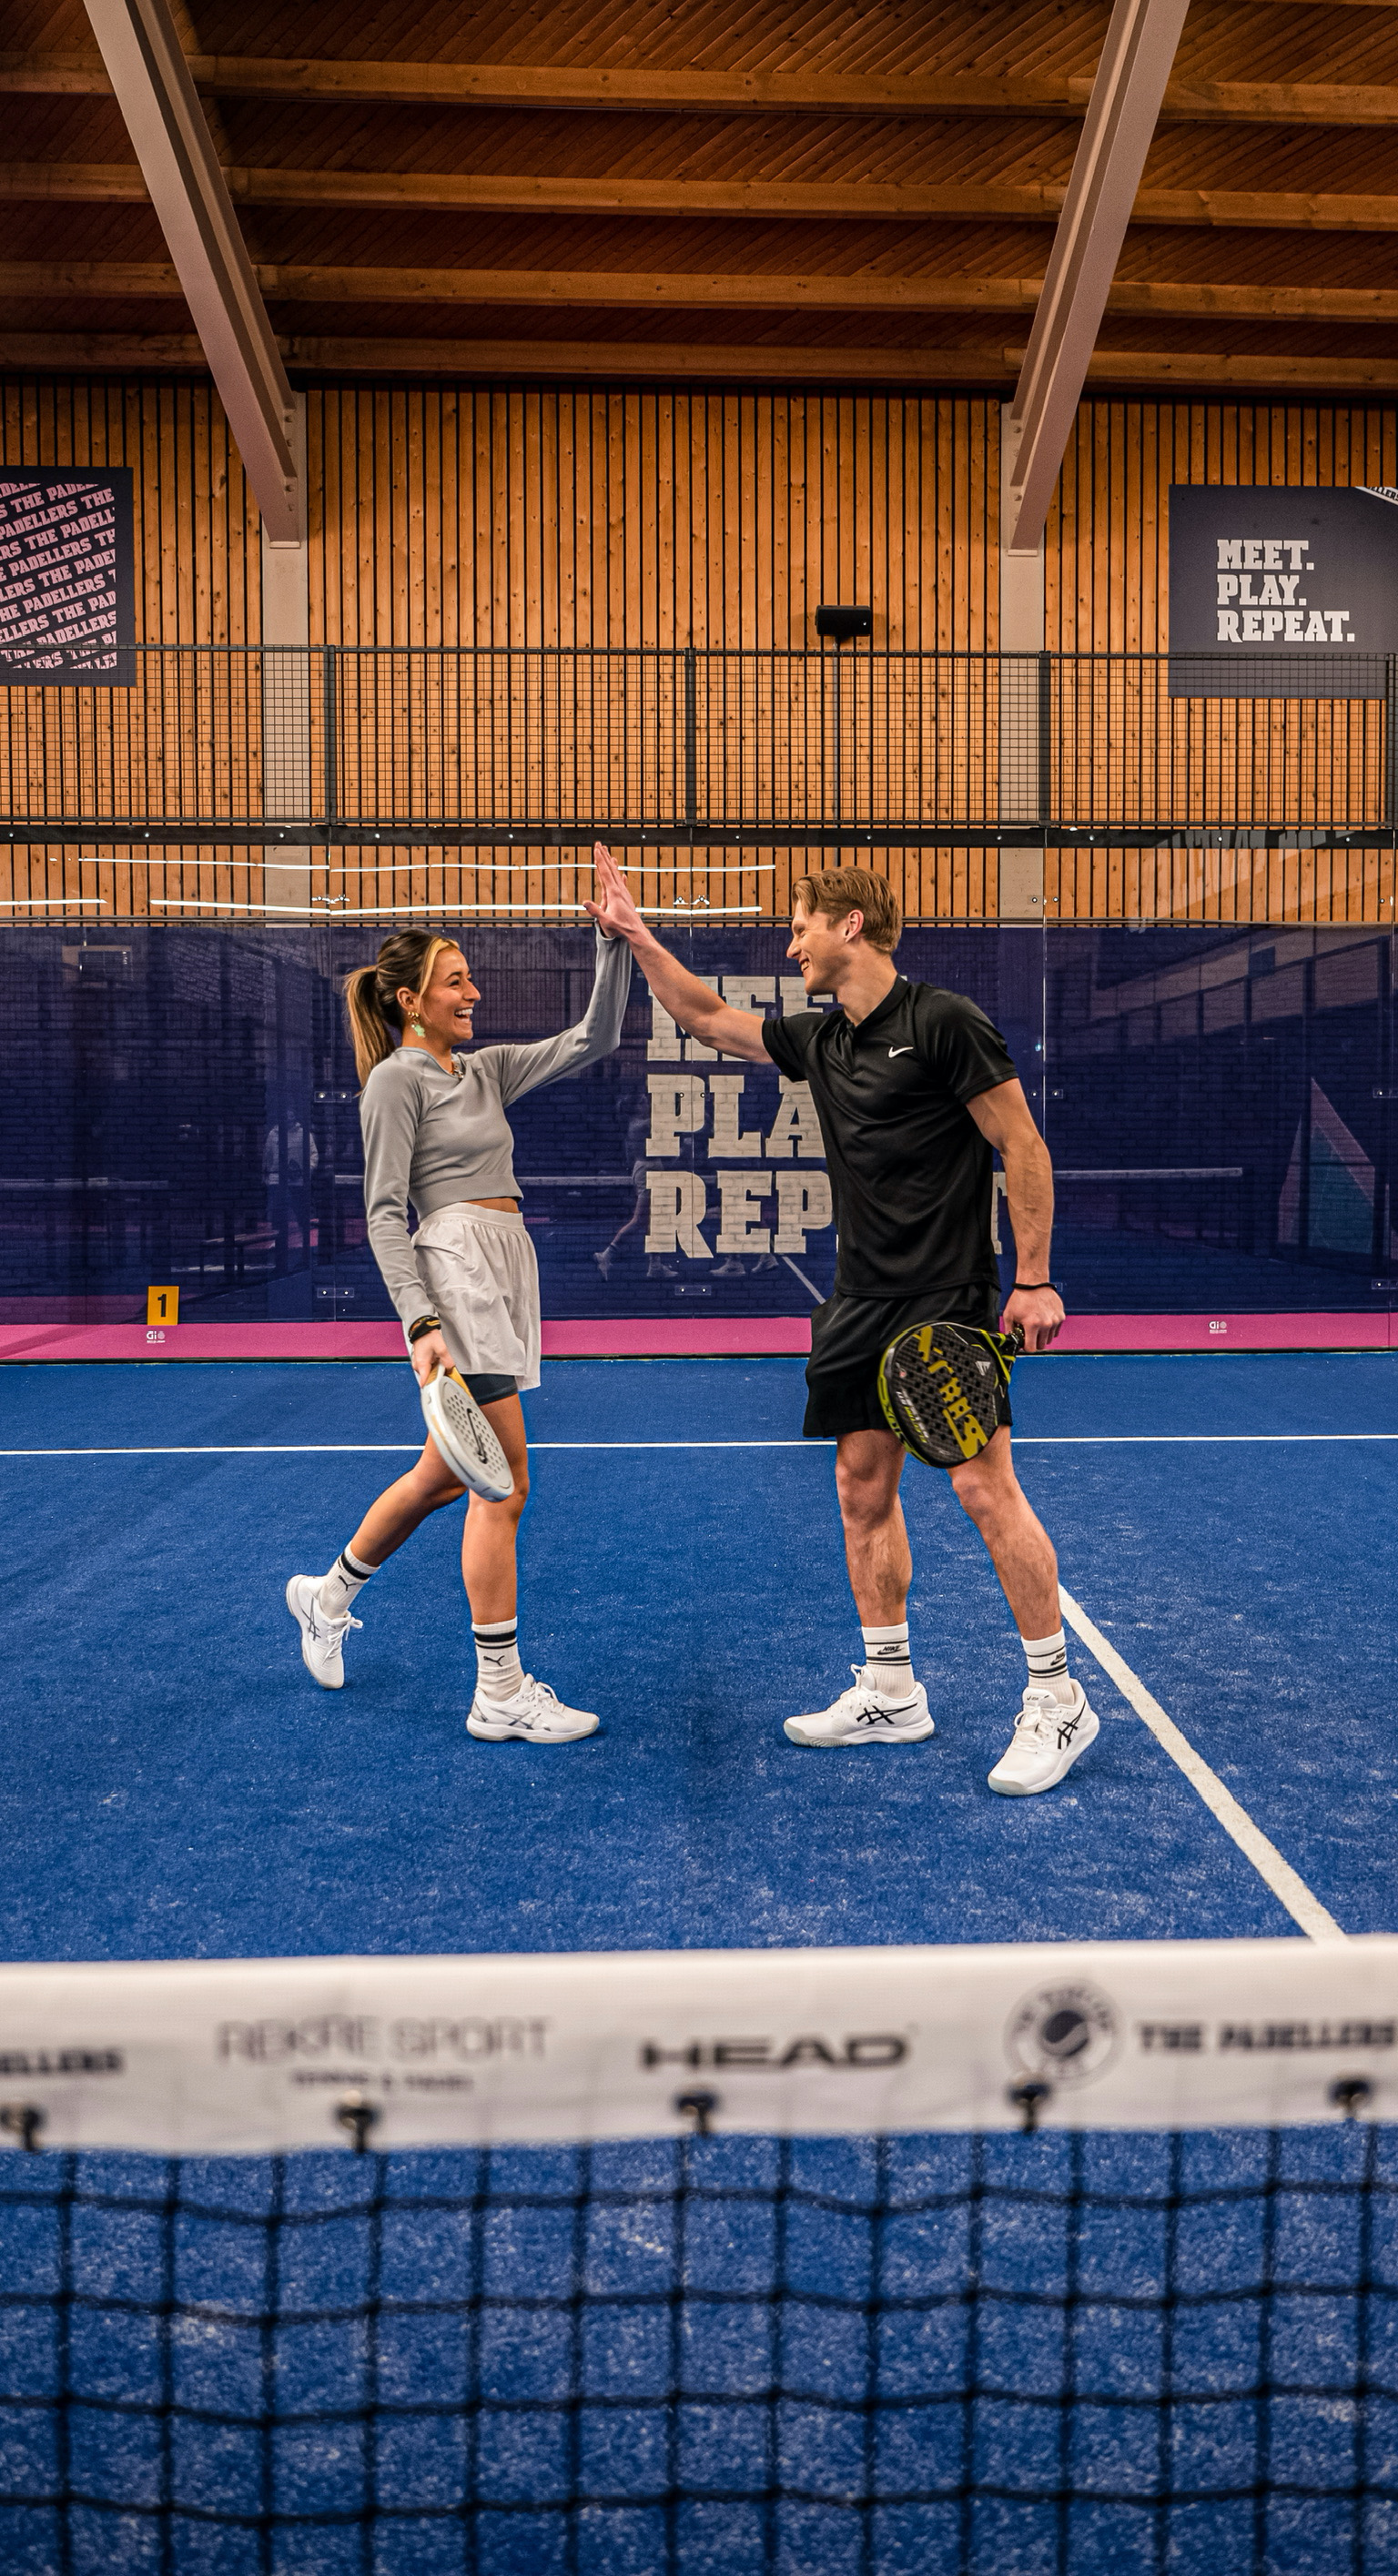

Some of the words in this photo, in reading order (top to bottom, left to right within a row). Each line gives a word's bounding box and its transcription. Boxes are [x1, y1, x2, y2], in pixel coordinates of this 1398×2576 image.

[10, 491, 45, 512] THE
[80, 488, 115, 510] THE
[24, 528, 58, 551] THE
[60, 507, 115, 539] PADELL
[8, 537, 92, 577] PADELLERS
[37, 564, 73, 587] THE
[74, 549, 116, 575] PADE
[1217, 539, 1314, 571] MEET.
[23, 573, 106, 614] PADELLERS
[1217, 574, 1307, 606] PLAY.
[52, 601, 86, 623] THE
[1217, 610, 1355, 643] REPEAT.
[646, 1074, 826, 1157] PLA
[157, 1293, 167, 1318] 1
[391, 2015, 551, 2060] SPORT
[641, 2036, 908, 2068] HEAD
[1139, 2020, 1203, 2054] THE
